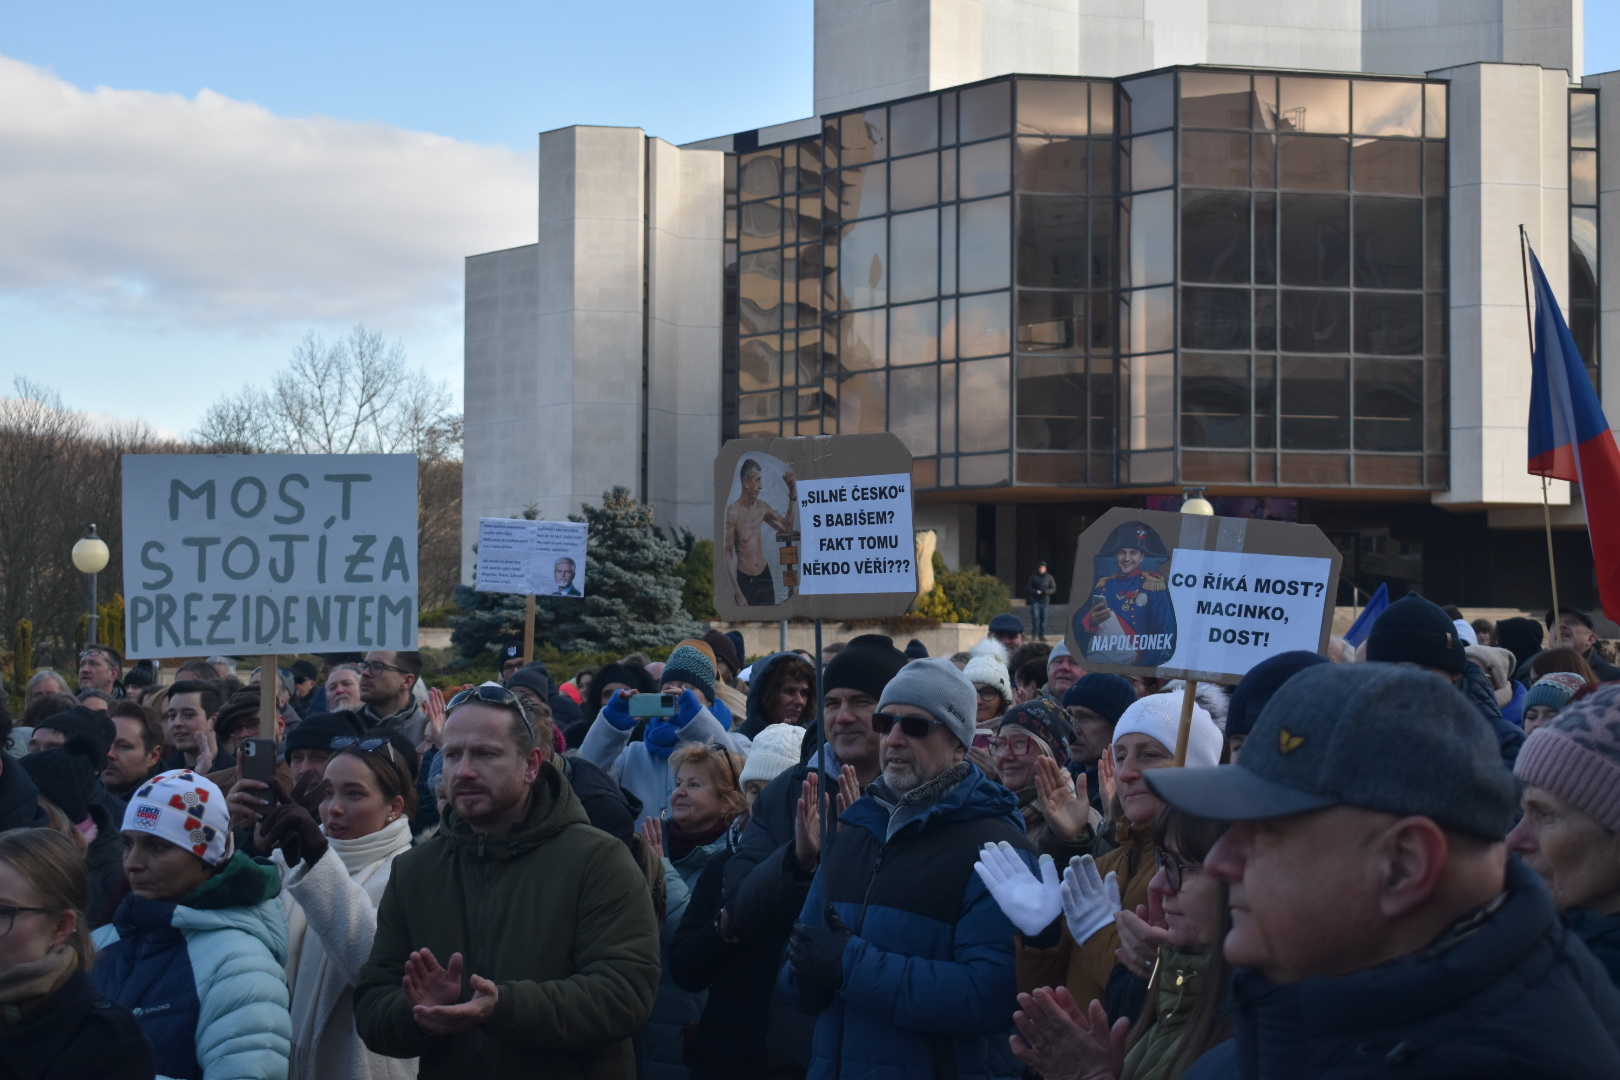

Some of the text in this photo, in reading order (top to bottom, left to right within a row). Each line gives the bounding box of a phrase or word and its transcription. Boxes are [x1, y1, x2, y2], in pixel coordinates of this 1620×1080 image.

[168, 473, 372, 525] MOST
[801, 484, 905, 508] „SILNÉ ČESKO“
[813, 508, 895, 528] S BABIŠEM?
[140, 515, 410, 590] STOJÍ ZA
[819, 535, 899, 551] FAKT TOMU
[802, 556, 910, 576] NĚKDO VĚŘÍ???
[1171, 572, 1325, 598] CO ŘÍKÁ MOST?
[129, 592, 413, 652] PREZIDENTEM
[1196, 600, 1289, 625] MACINKO,
[1091, 633, 1174, 651] NAPOLEONEK
[1208, 627, 1270, 647] DOST!
[137, 811, 158, 820] team
[139, 806, 160, 815] czech
[145, 1003, 170, 1014] SIMOND
